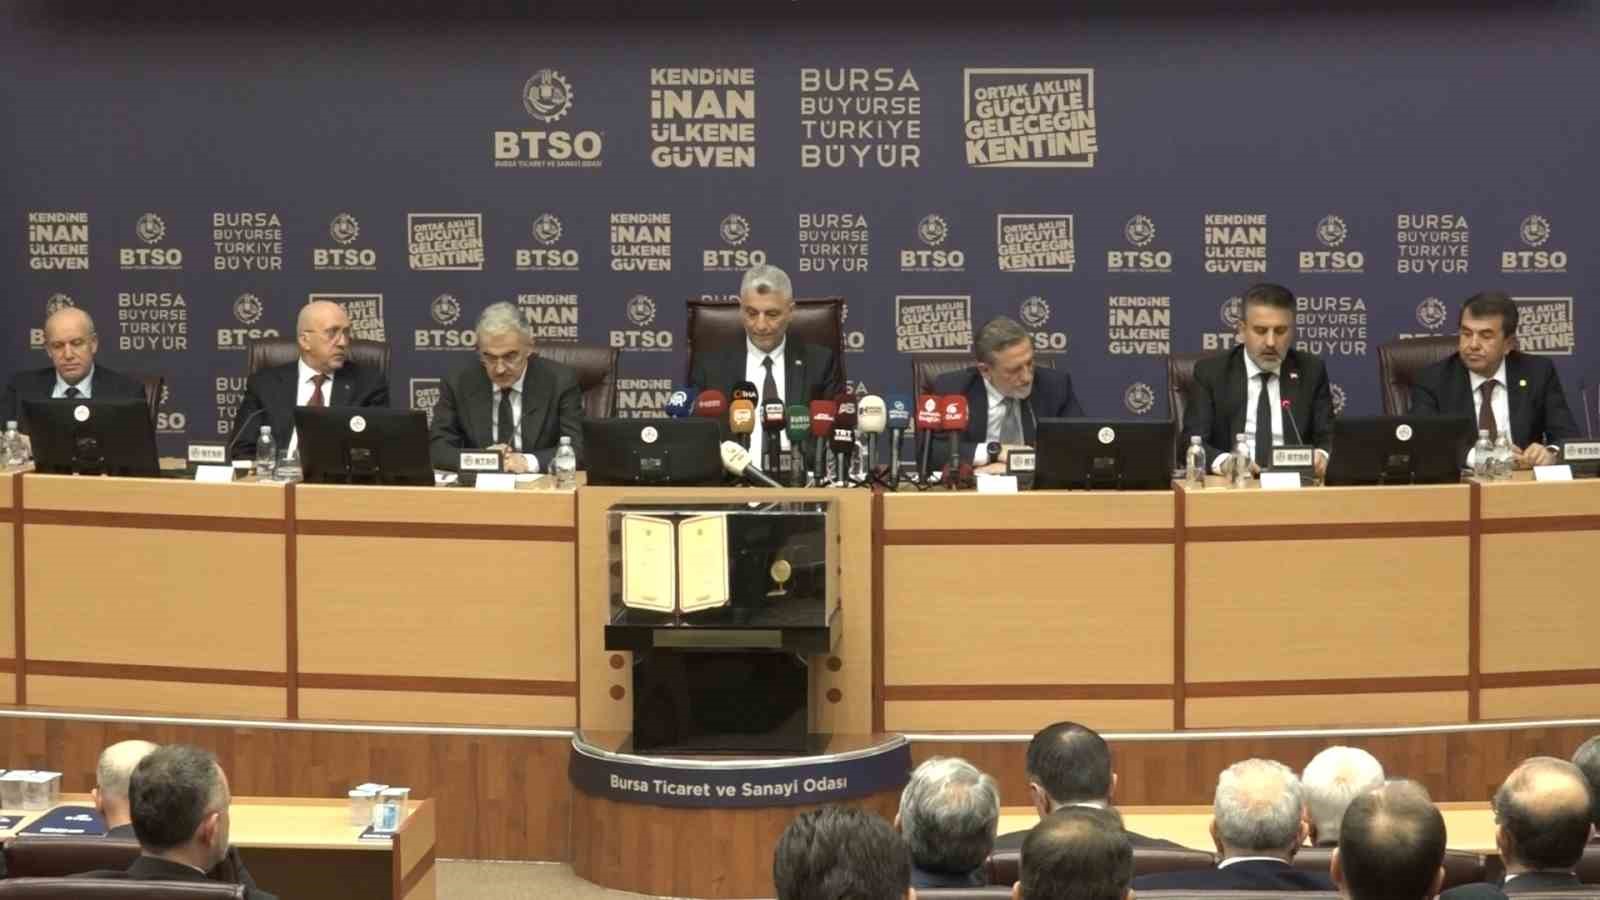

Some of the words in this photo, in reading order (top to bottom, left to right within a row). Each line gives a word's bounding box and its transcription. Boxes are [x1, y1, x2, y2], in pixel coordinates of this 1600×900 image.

[800, 68, 920, 92] BURSA
[974, 83, 1029, 101] ORTAK
[1033, 78, 1082, 96] AKLIN
[651, 90, 755, 119] İNAN
[800, 97, 920, 115] BÜYÜRSE
[651, 123, 755, 142] ÜLKENE
[494, 131, 602, 159] BTSO
[651, 146, 755, 168] GÜVEN
[800, 144, 920, 168] BÜYÜR
[214, 213, 282, 226] BURSA
[800, 214, 868, 228] BURSA
[1398, 214, 1469, 228] BURSA
[611, 226, 670, 243] İNAN
[120, 248, 182, 264] BTSO
[214, 256, 282, 270] BÜYÜR
[314, 249, 376, 266] BTSO
[516, 249, 579, 266] BTSO
[704, 250, 766, 266] BTSO
[900, 251, 964, 267] BTSO
[1108, 252, 1172, 268] BTSO
[1300, 252, 1364, 269] BTSO
[1502, 252, 1568, 269] BTSO
[611, 258, 670, 271] GÜVEN
[800, 258, 868, 272] BÜYÜR
[1204, 260, 1266, 273] GÜVEN
[1398, 258, 1469, 274] BÜYÜR
[118, 294, 187, 307] BURSA
[1296, 296, 1368, 311] BURSA
[1109, 310, 1170, 326] İNAN
[118, 336, 187, 350] BÜYÜR
[414, 330, 478, 346] BTSO
[610, 331, 672, 348] BTSO
[1109, 342, 1170, 354] GÜVEN
[610, 774, 649, 793] Bursa
[652, 779, 711, 797] Ticaret
[716, 784, 736, 797] ve
[742, 778, 798, 798] Sanayi
[803, 776, 848, 792] Odası
